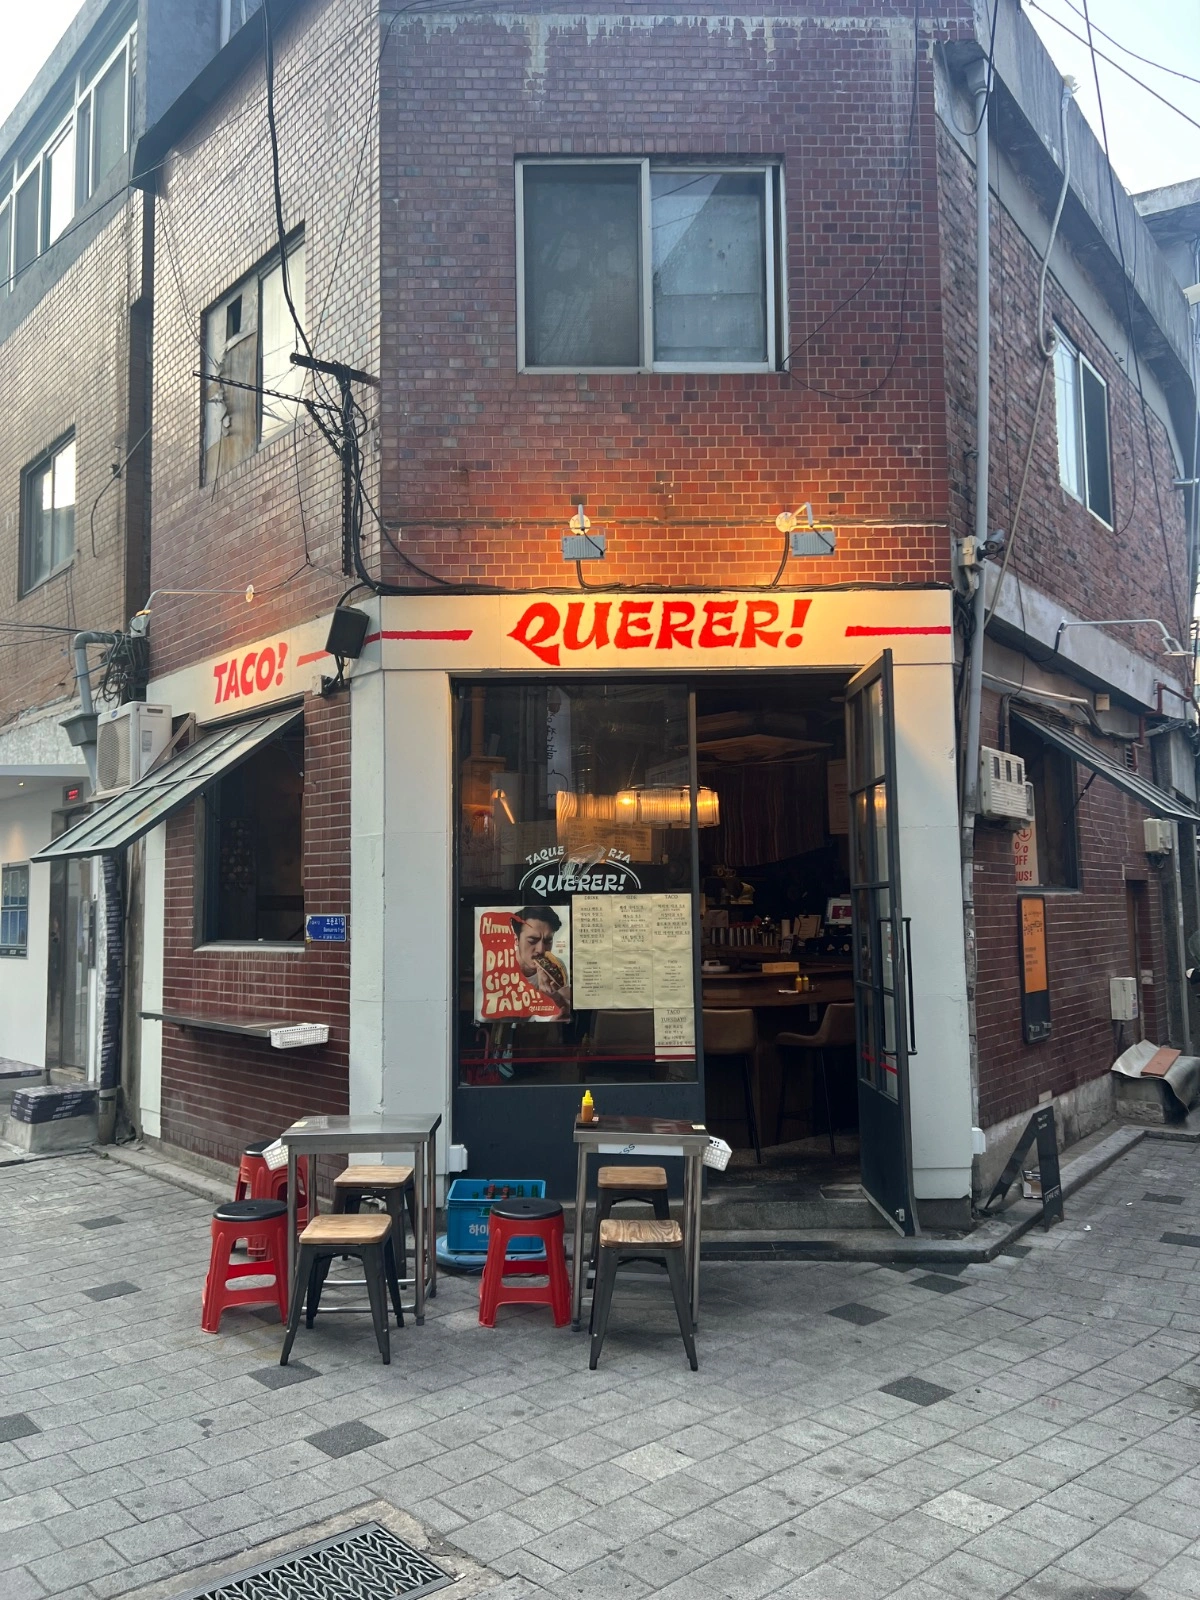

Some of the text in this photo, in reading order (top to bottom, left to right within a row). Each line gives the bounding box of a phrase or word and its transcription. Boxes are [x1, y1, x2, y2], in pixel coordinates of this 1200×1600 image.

[507, 599, 813, 666] QUERER!
[213, 642, 288, 704] TACO!
[525, 845, 631, 866] TAQUE RIA
[531, 874, 627, 897] QUERER!
